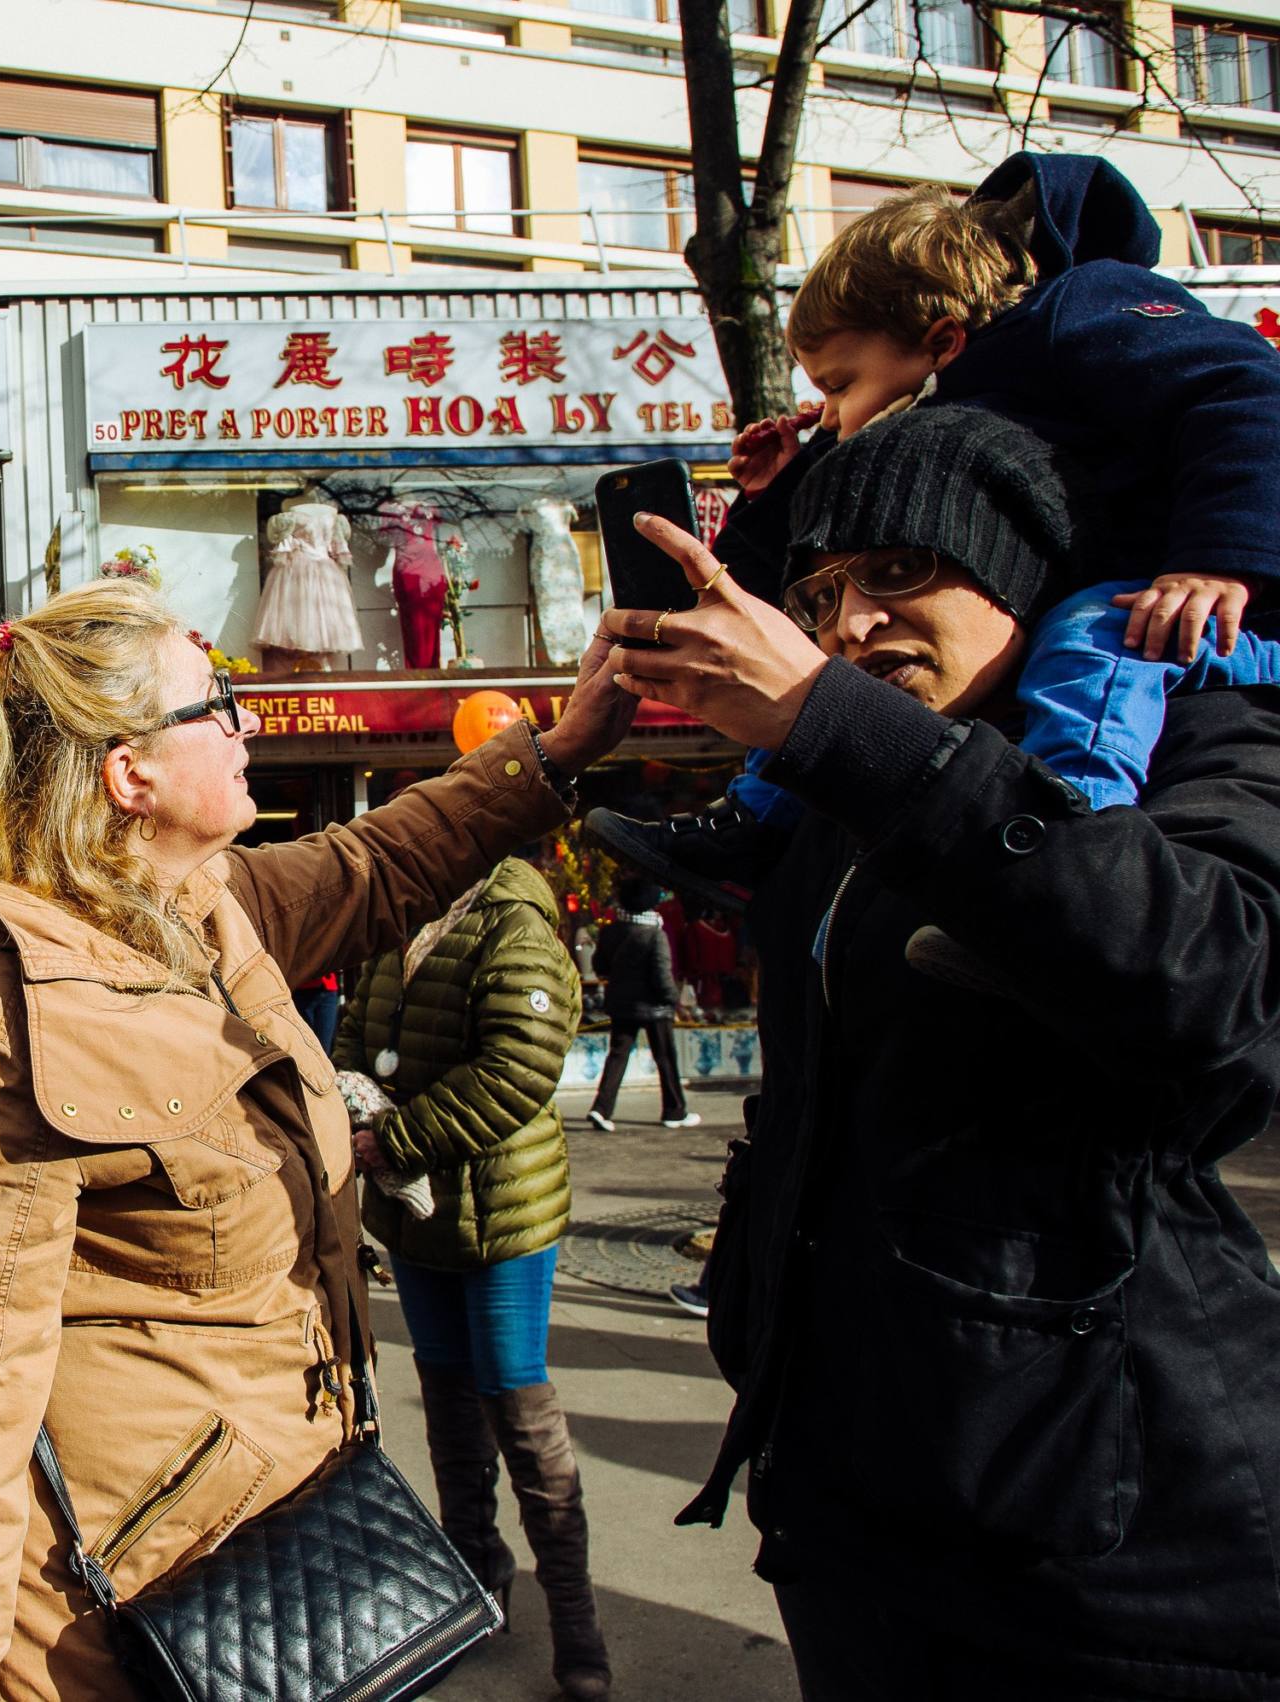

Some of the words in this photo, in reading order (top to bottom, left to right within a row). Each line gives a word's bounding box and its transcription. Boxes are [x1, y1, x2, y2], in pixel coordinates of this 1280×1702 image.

[121, 408, 208, 441] PRET
[218, 408, 240, 439] A
[251, 405, 389, 438] PORTER
[404, 394, 526, 436] HOA
[549, 392, 617, 434] LY
[637, 401, 702, 433] TEL
[95, 423, 117, 441] 50
[307, 697, 335, 715] EN
[265, 716, 290, 734] ET
[297, 714, 370, 733] DETAIL
